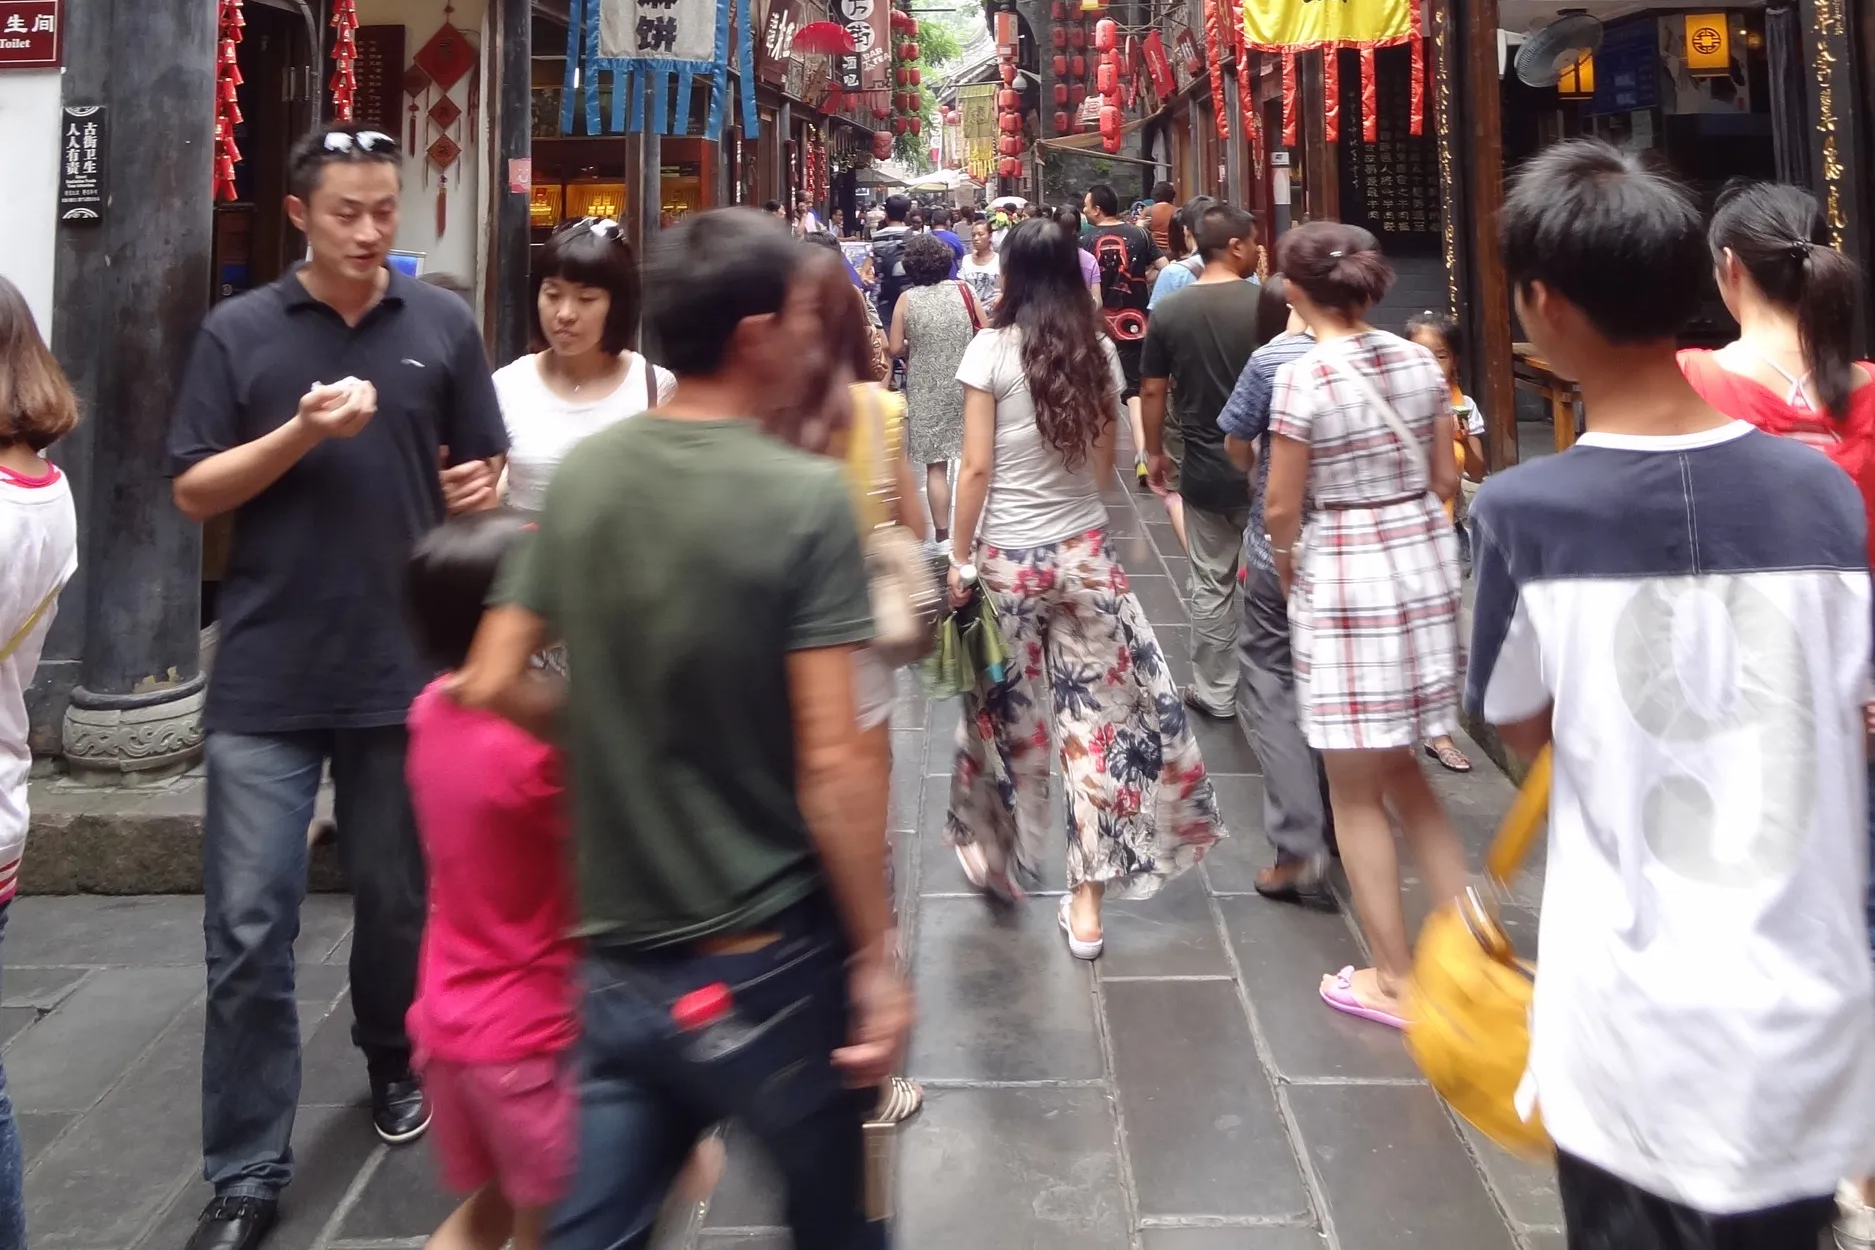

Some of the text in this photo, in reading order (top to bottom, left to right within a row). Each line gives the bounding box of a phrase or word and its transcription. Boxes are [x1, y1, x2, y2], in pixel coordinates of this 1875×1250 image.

[4, 13, 55, 34] 生间
[0, 38, 31, 49] Toilet
[861, 47, 883, 60] BAR
[841, 55, 859, 87] 酒吧
[65, 122, 81, 175] 人人有责
[82, 121, 98, 174] 古街卫生
